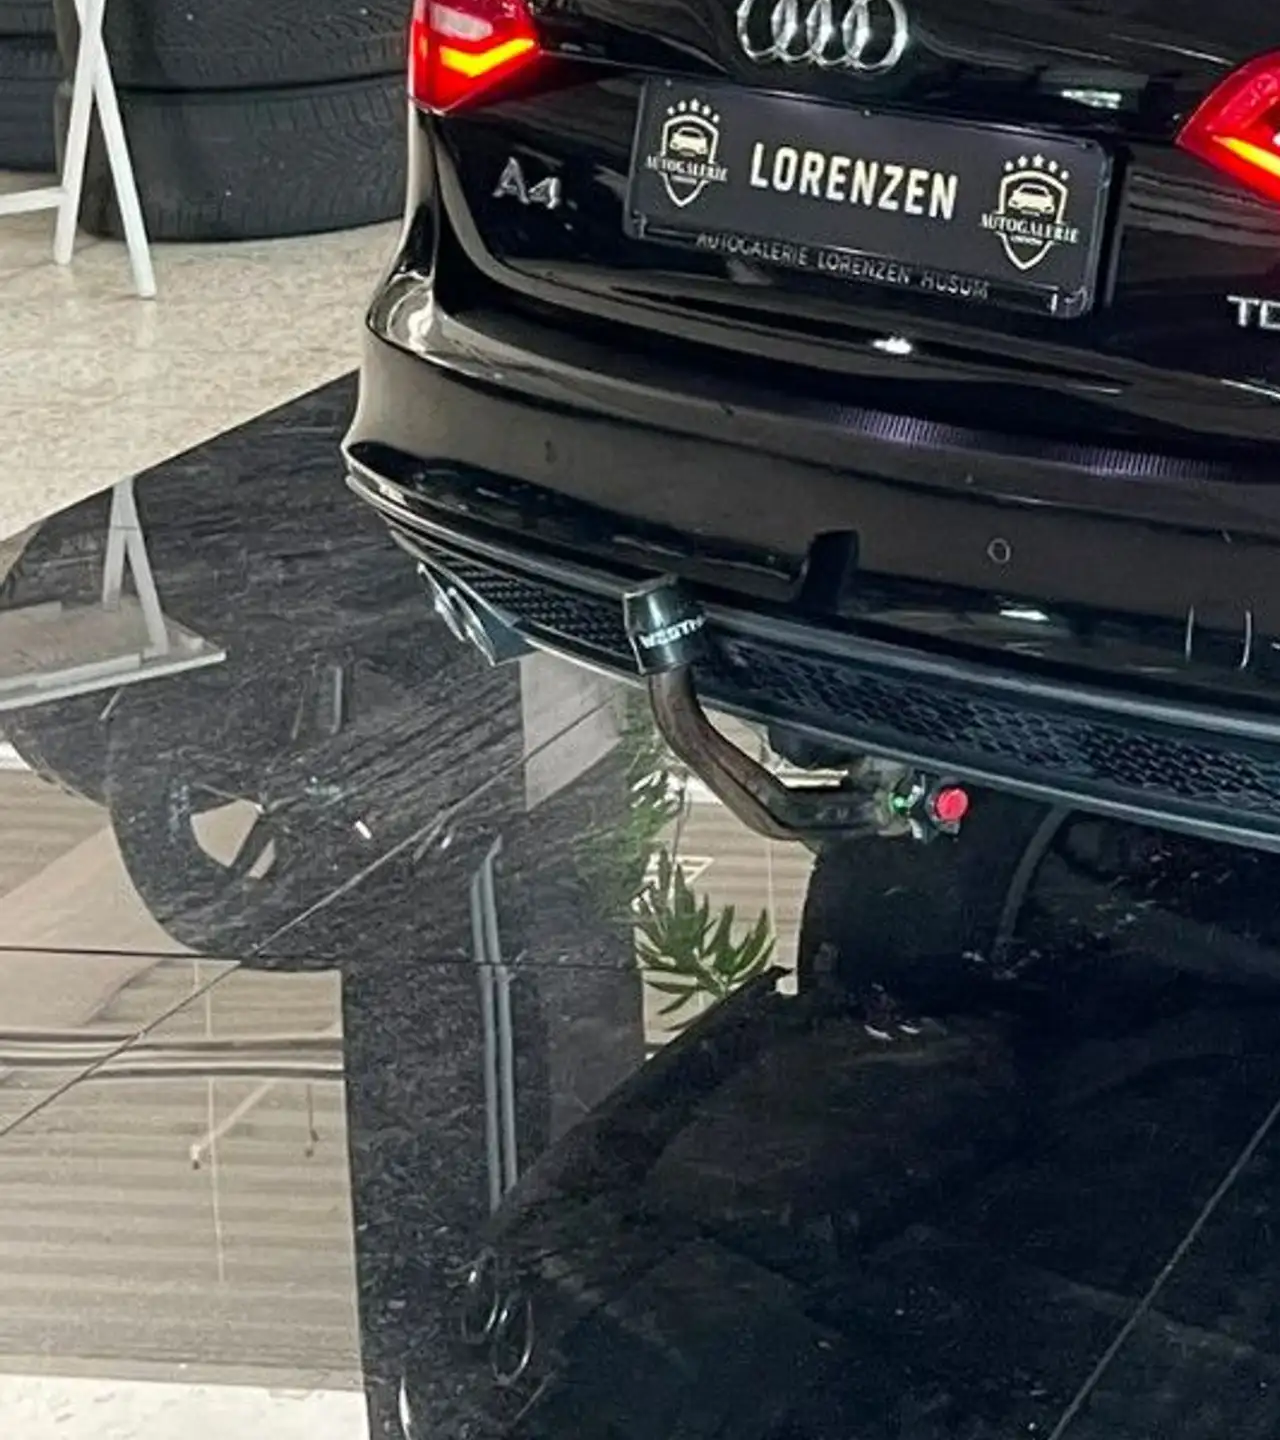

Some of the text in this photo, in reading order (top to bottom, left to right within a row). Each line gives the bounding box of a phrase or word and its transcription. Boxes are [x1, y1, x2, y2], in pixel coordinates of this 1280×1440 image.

[492, 156, 561, 210] A4
[749, 142, 959, 220] LORENZEN
[979, 212, 1080, 244] AUTOGALERIE
[695, 231, 991, 300] AUTOGALERIE LORENZEN HUSUM
